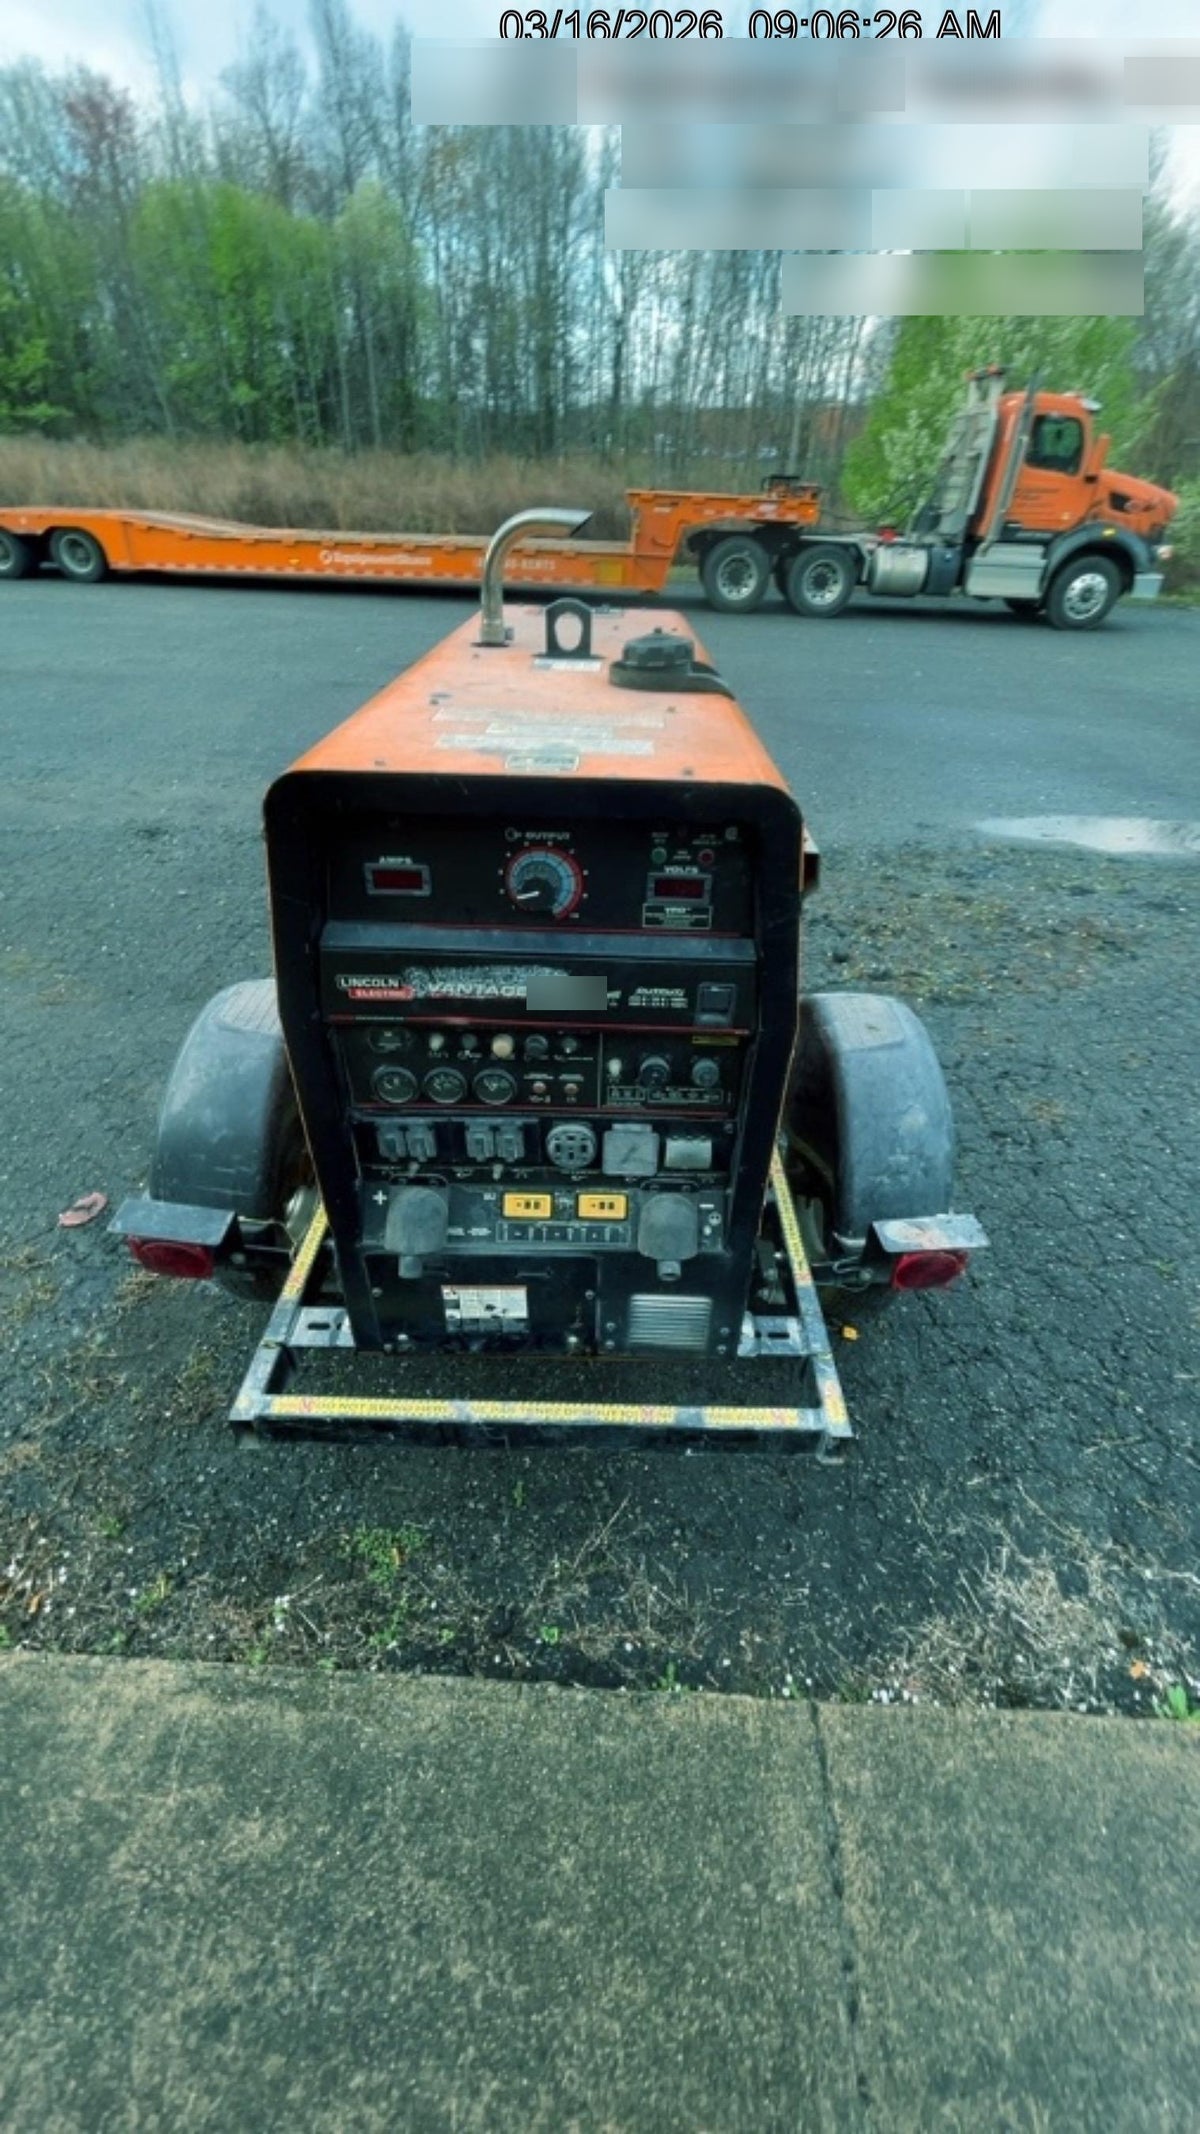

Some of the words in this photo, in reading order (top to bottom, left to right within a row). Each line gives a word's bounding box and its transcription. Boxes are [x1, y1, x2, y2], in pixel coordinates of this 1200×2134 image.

[340, 976, 400, 988] LINCOLN
[354, 989, 407, 999] ELECTRIC
[427, 983, 527, 997] VANTAGE
